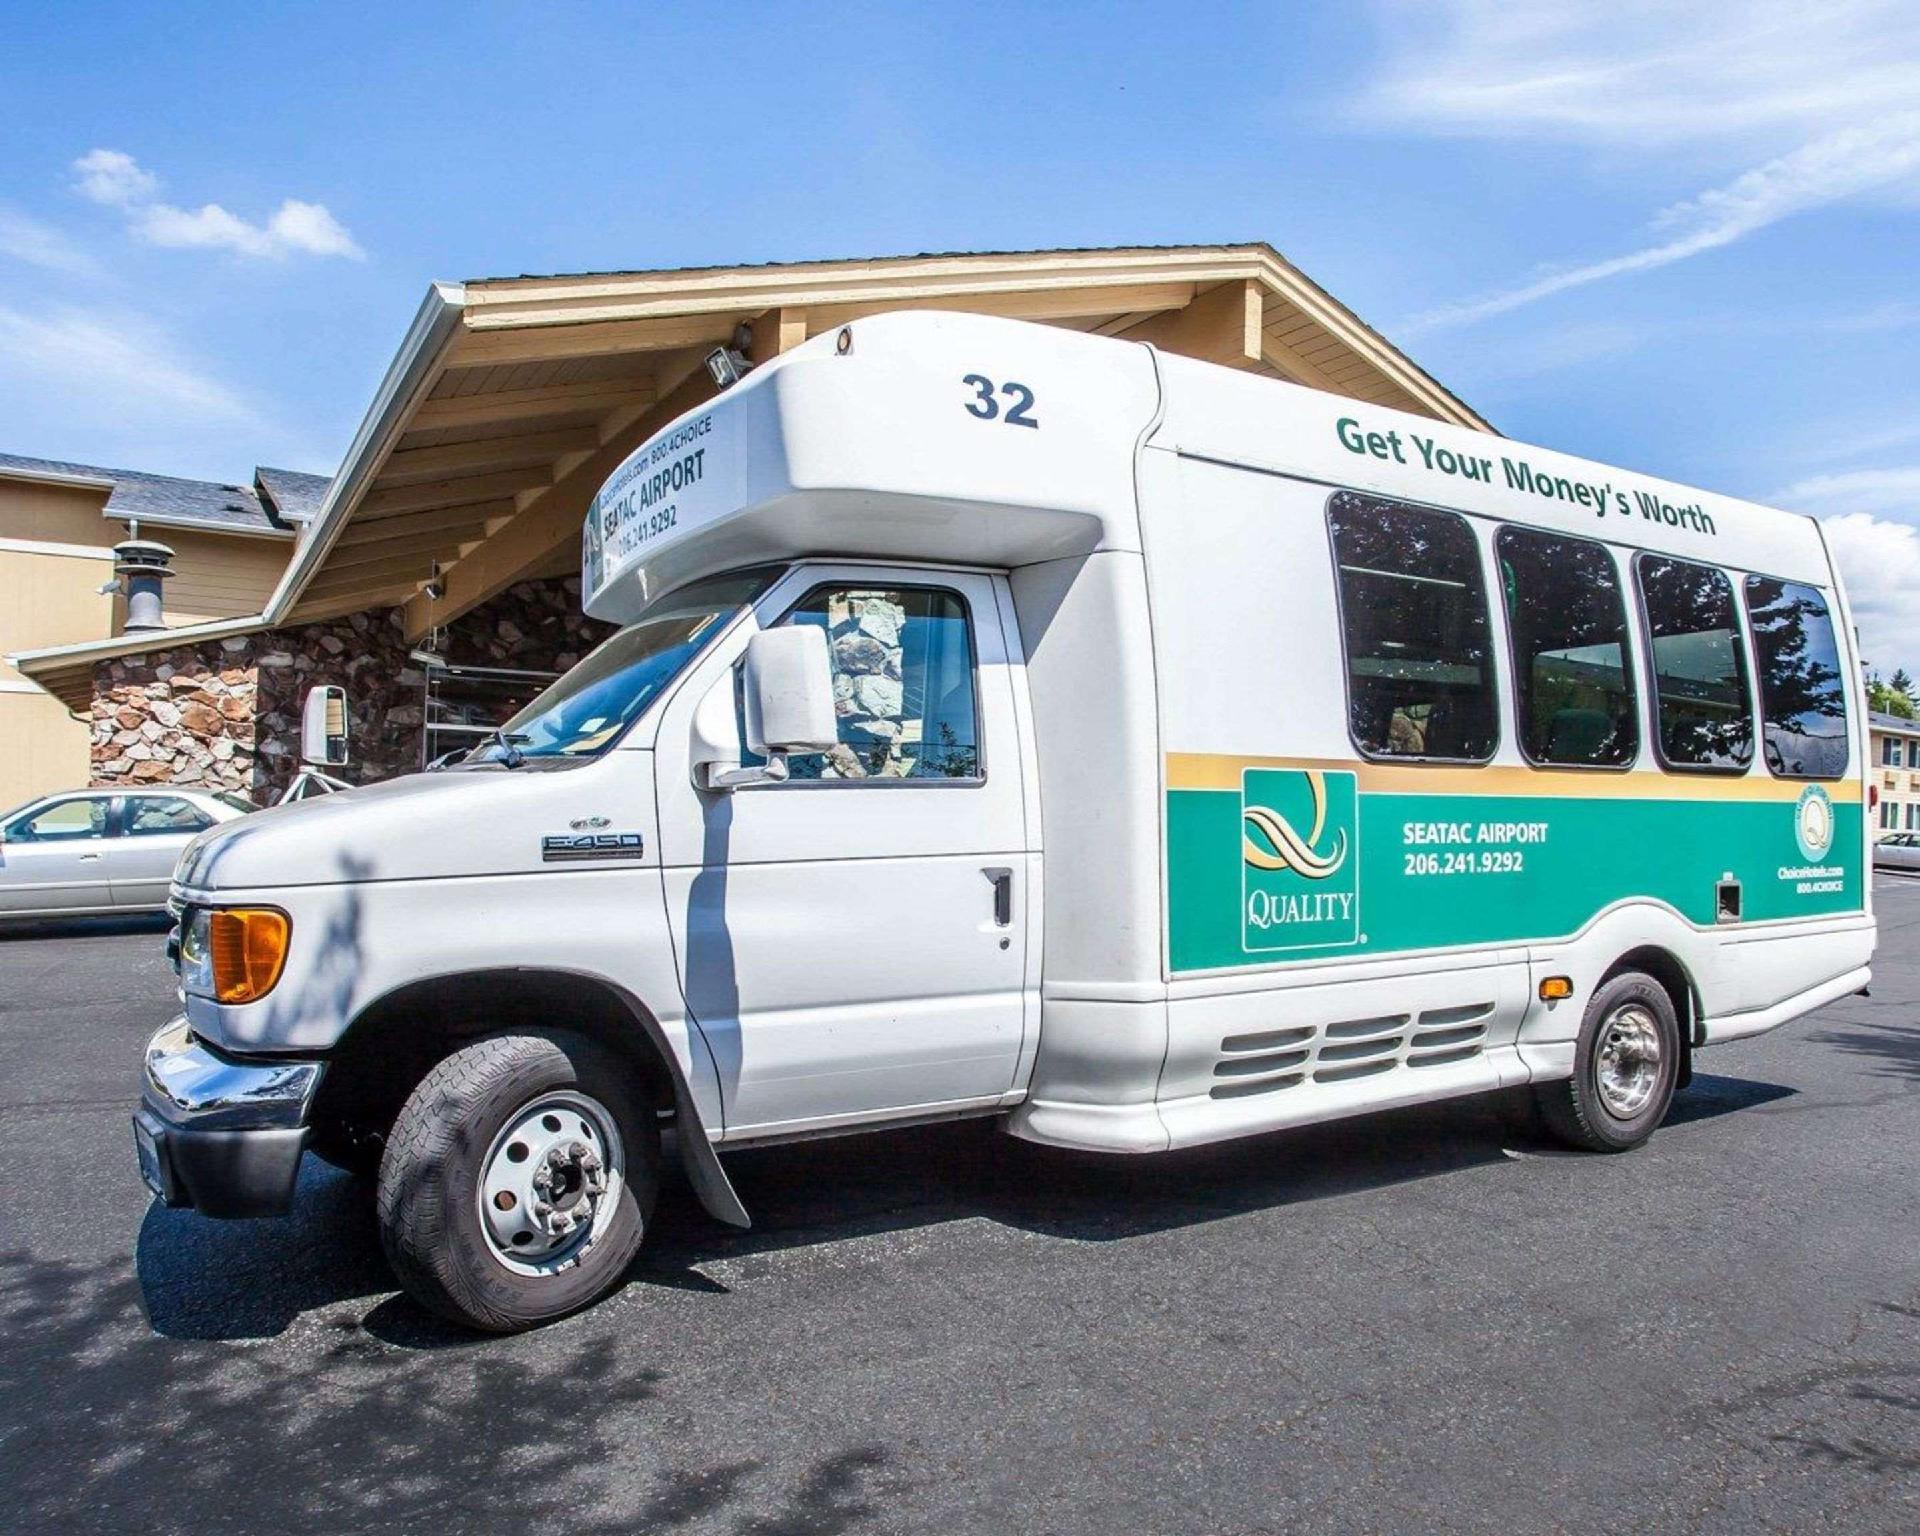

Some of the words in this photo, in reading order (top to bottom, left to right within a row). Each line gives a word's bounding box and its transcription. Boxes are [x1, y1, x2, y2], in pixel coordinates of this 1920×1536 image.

[963, 374, 1039, 429] 32
[651, 415, 712, 465] 800.4CHOICE
[604, 490, 637, 542] SEATAC
[640, 448, 705, 512] AIRPORT
[1336, 417, 1406, 464] Get
[1411, 434, 1492, 483] Your
[1501, 456, 1630, 518] Money's
[1634, 490, 1716, 535] Worth
[1403, 822, 1472, 844] SEATAC
[1476, 822, 1548, 843] AIRPORT
[1404, 851, 1523, 875] 206.241.9292
